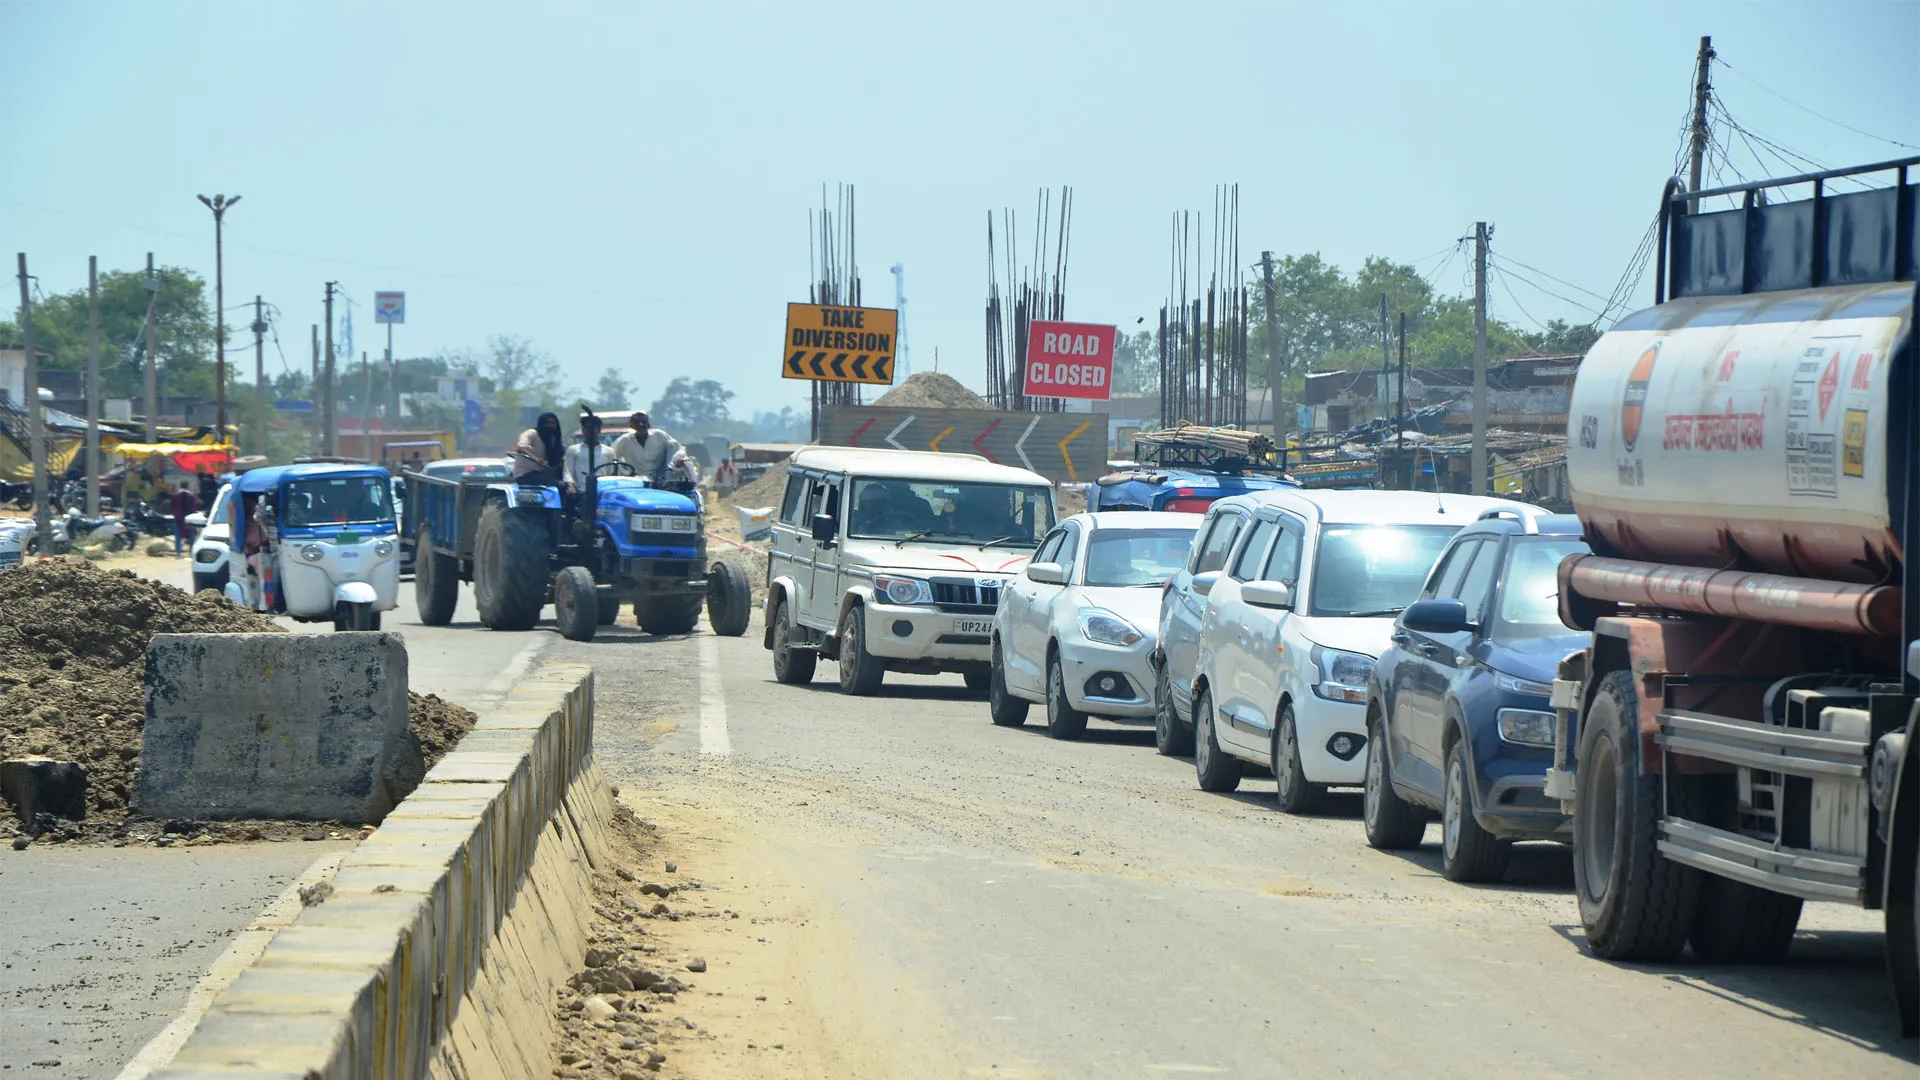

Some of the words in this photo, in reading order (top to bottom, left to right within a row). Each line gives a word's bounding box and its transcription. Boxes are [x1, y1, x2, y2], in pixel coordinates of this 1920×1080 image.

[821, 308, 865, 329] TAKE
[792, 328, 890, 352] DIVERSION
[1043, 332, 1099, 356] ROAD
[1030, 361, 1105, 387] CLOSED
